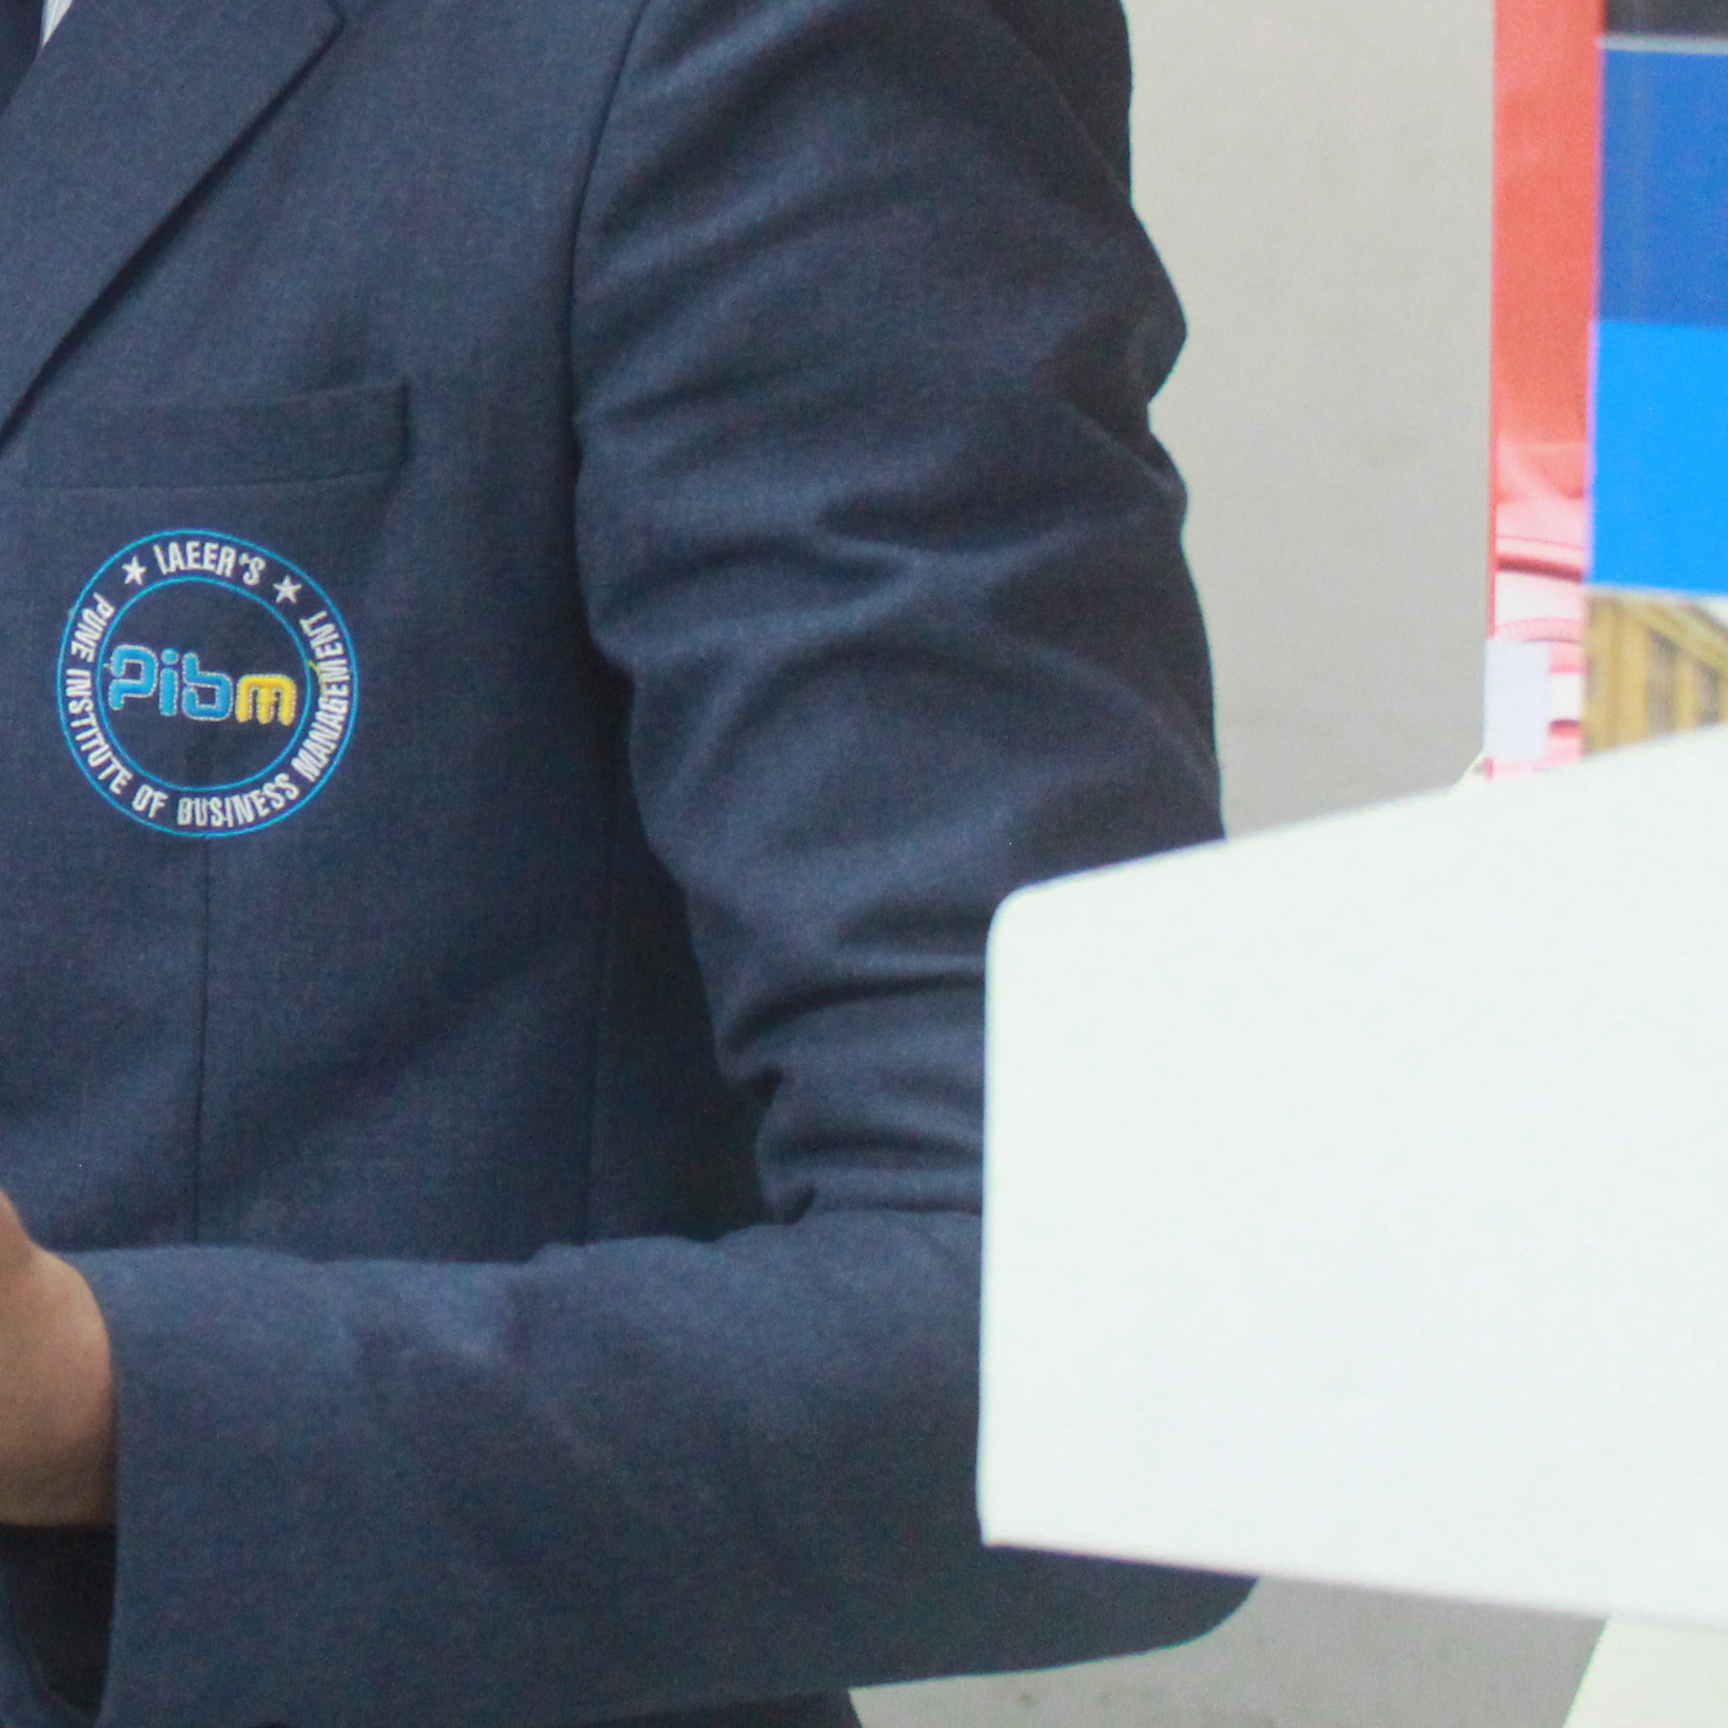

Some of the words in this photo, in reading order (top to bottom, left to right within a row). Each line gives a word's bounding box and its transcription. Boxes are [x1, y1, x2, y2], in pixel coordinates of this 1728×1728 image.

[71, 592, 115, 663] PUNE
[65, 668, 133, 795] INSTITUTE
[291, 610, 351, 782] MANAGEMENT
[131, 784, 169, 818] OF
[176, 772, 300, 828] BUSINESS
